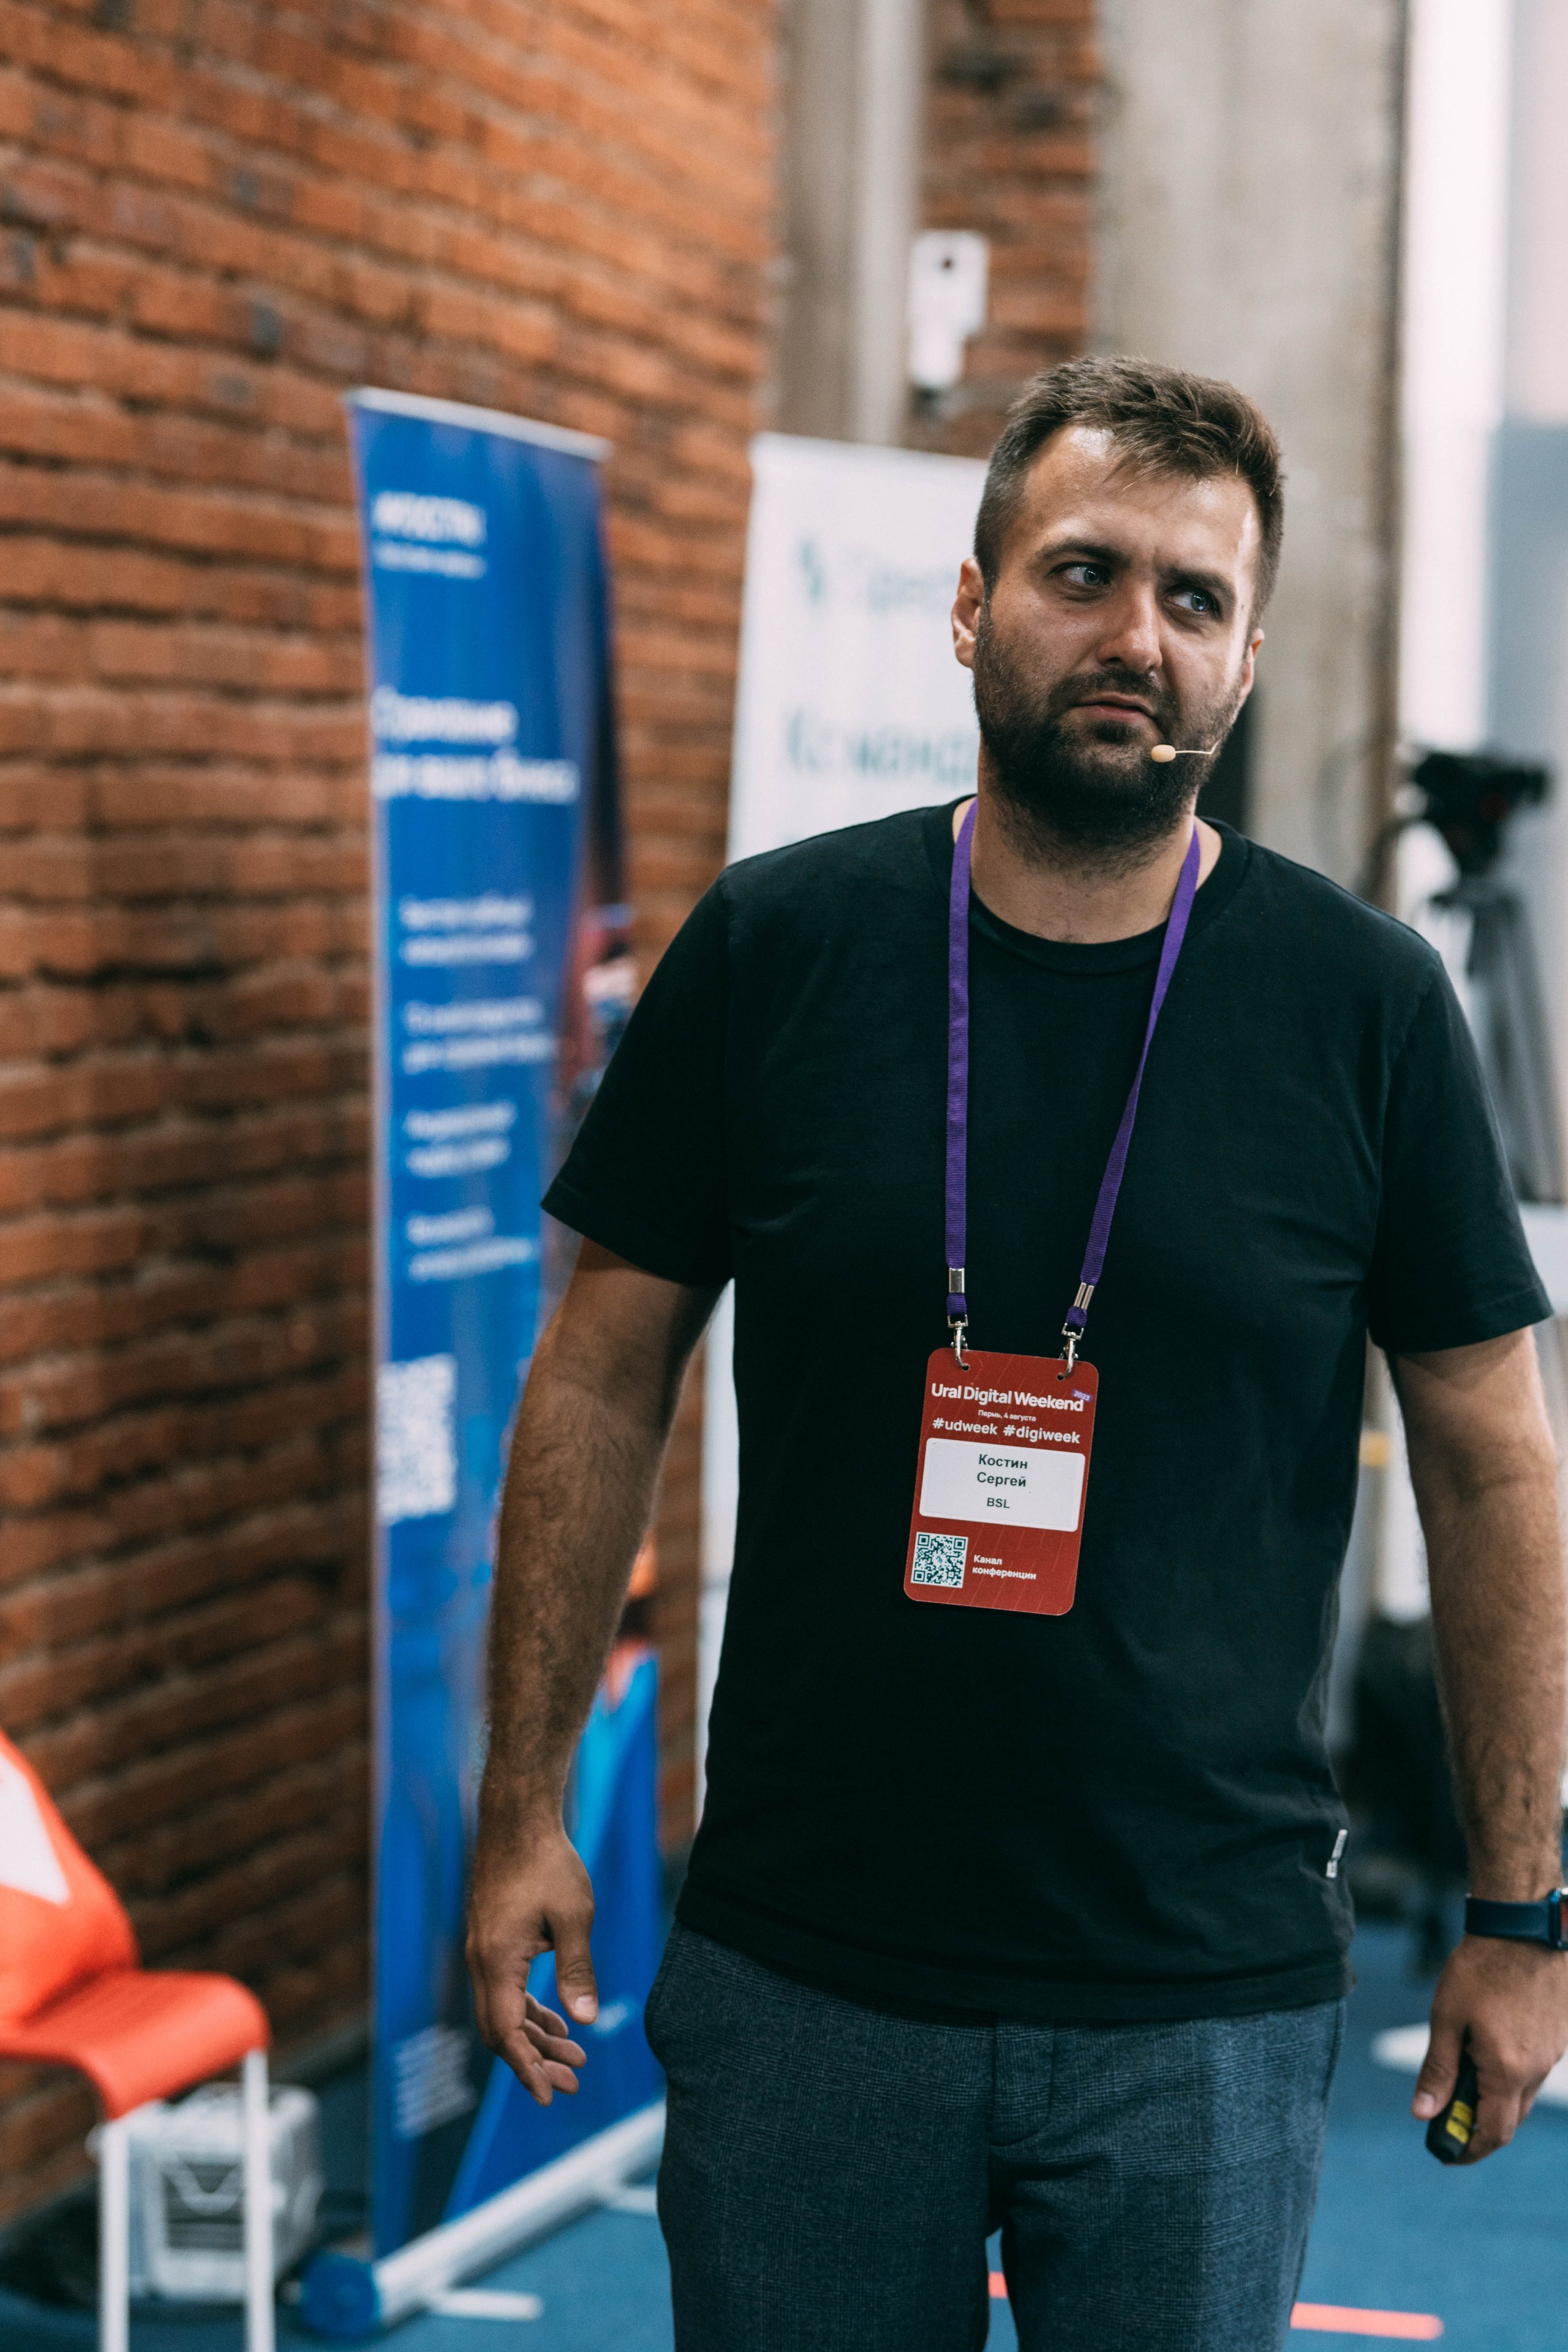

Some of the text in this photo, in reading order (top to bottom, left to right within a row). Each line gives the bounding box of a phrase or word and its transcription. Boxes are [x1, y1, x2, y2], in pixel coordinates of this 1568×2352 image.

[931, 1382, 1084, 1412] Ural Digital Weekend
[1073, 1390, 1091, 1401] 2023
[978, 1409, 1002, 1419] Пермь,
[1010, 1414, 1036, 1422] августа
[932, 1417, 1080, 1444] #udweek #digiweek
[979, 1453, 1028, 1469] Костин
[976, 1472, 1027, 1487] Сергей
[987, 1498, 1010, 1509] BSL
[973, 1555, 1003, 1565] Канал
[972, 1567, 1037, 1580] конференции
